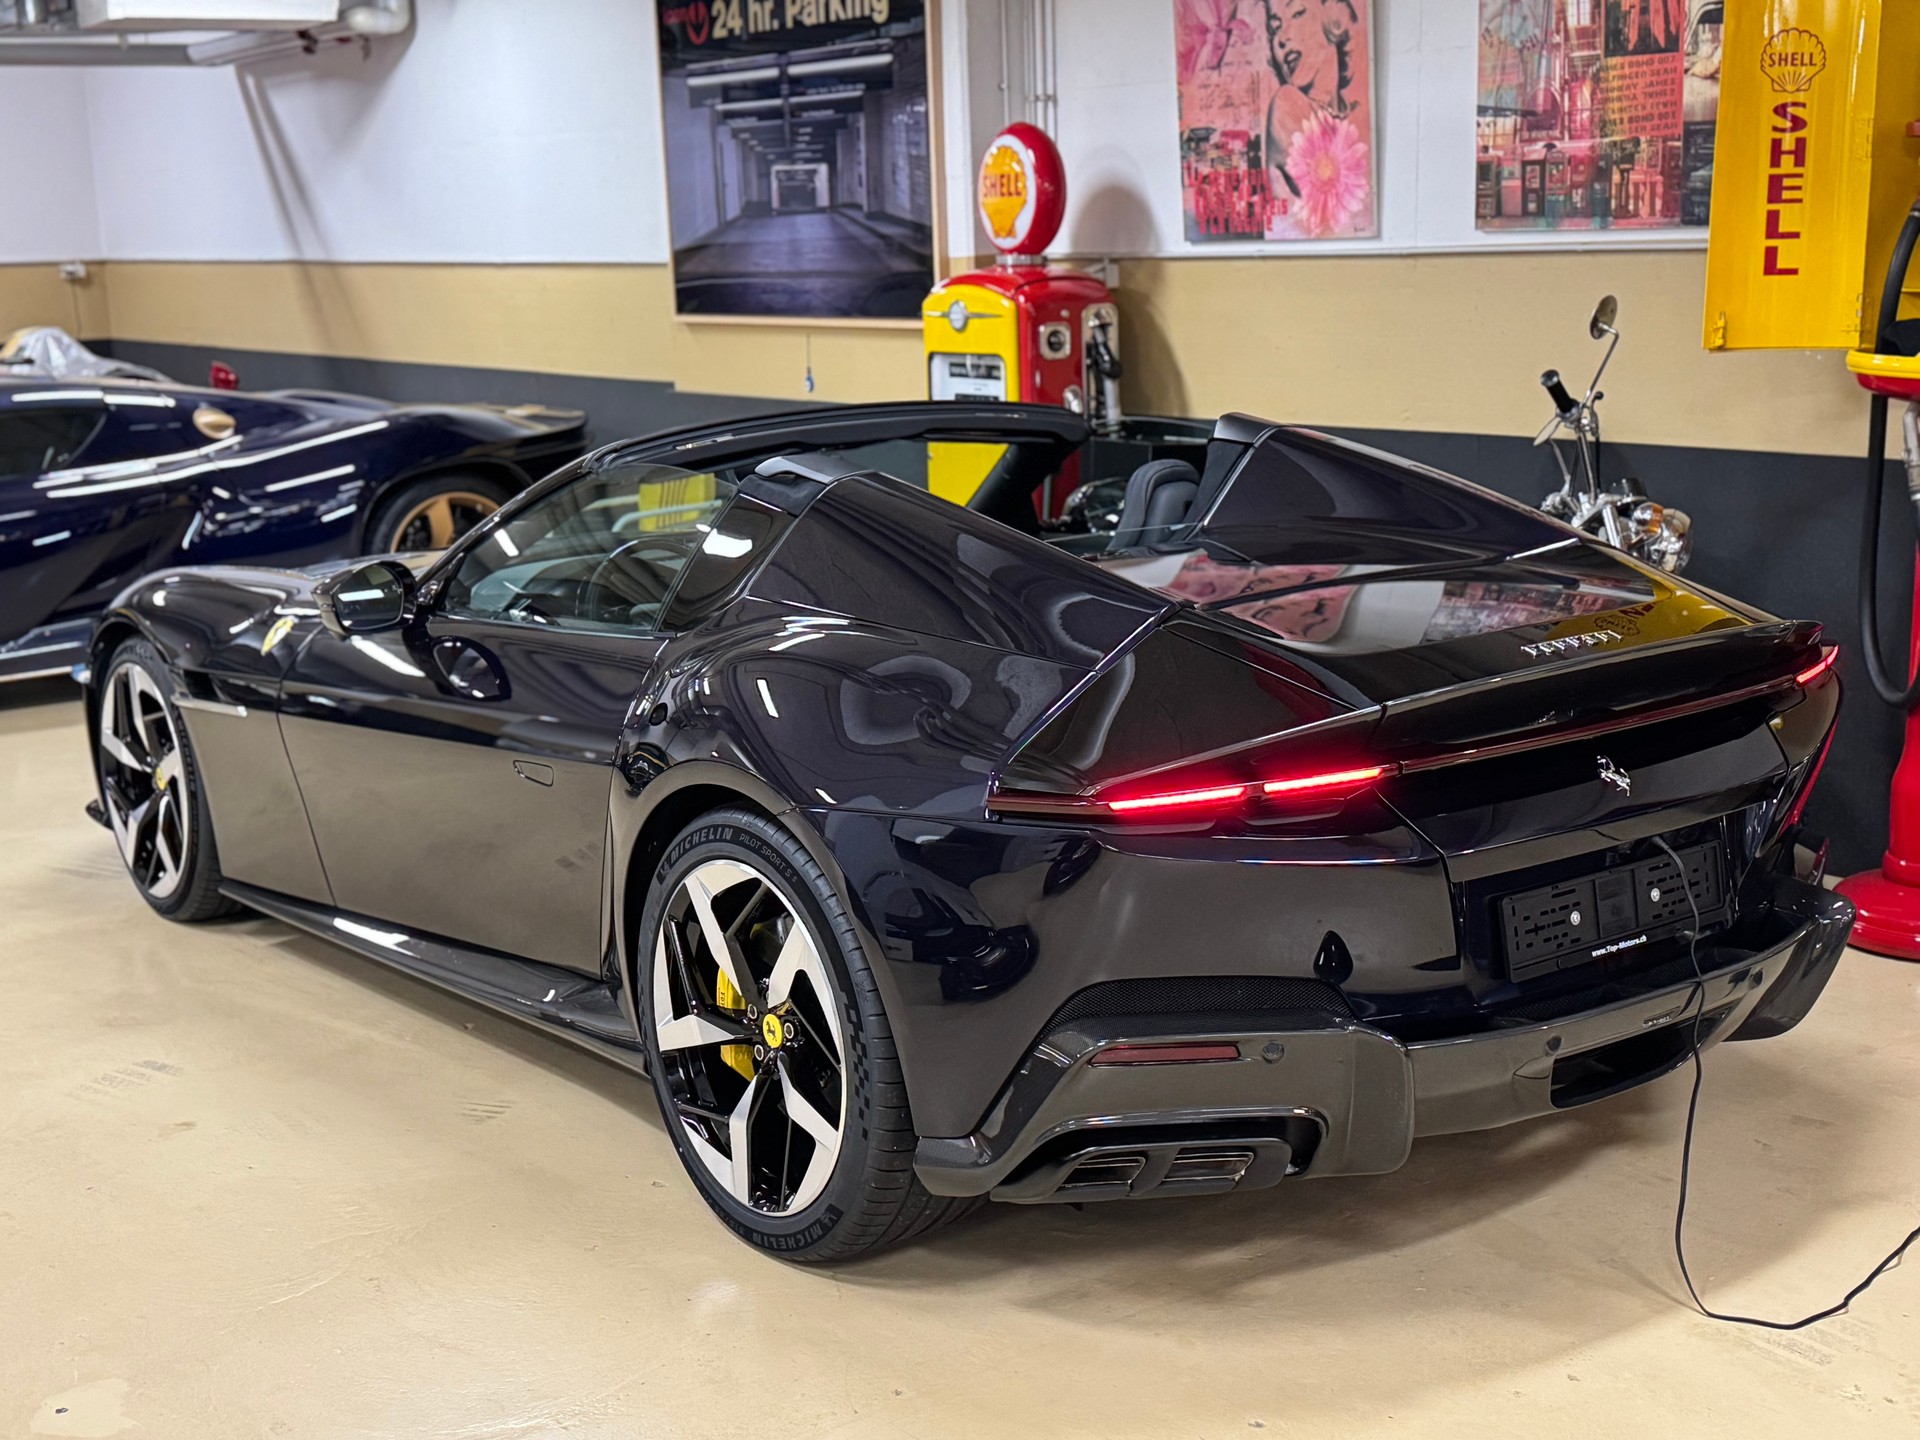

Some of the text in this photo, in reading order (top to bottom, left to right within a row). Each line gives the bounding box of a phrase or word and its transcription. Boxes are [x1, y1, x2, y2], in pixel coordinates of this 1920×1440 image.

[711, 0, 743, 39] 24
[749, 0, 779, 33] hr.
[785, 0, 889, 29] Parking
[1768, 52, 1817, 68] SHELL
[983, 173, 1022, 198] SHELL
[1763, 101, 1807, 276] SHELL
[671, 827, 733, 863] MICHELIN
[739, 833, 761, 849] PILOT
[761, 845, 786, 870] SPORT
[785, 868, 793, 877] S
[752, 1223, 823, 1249] MICHELIN
